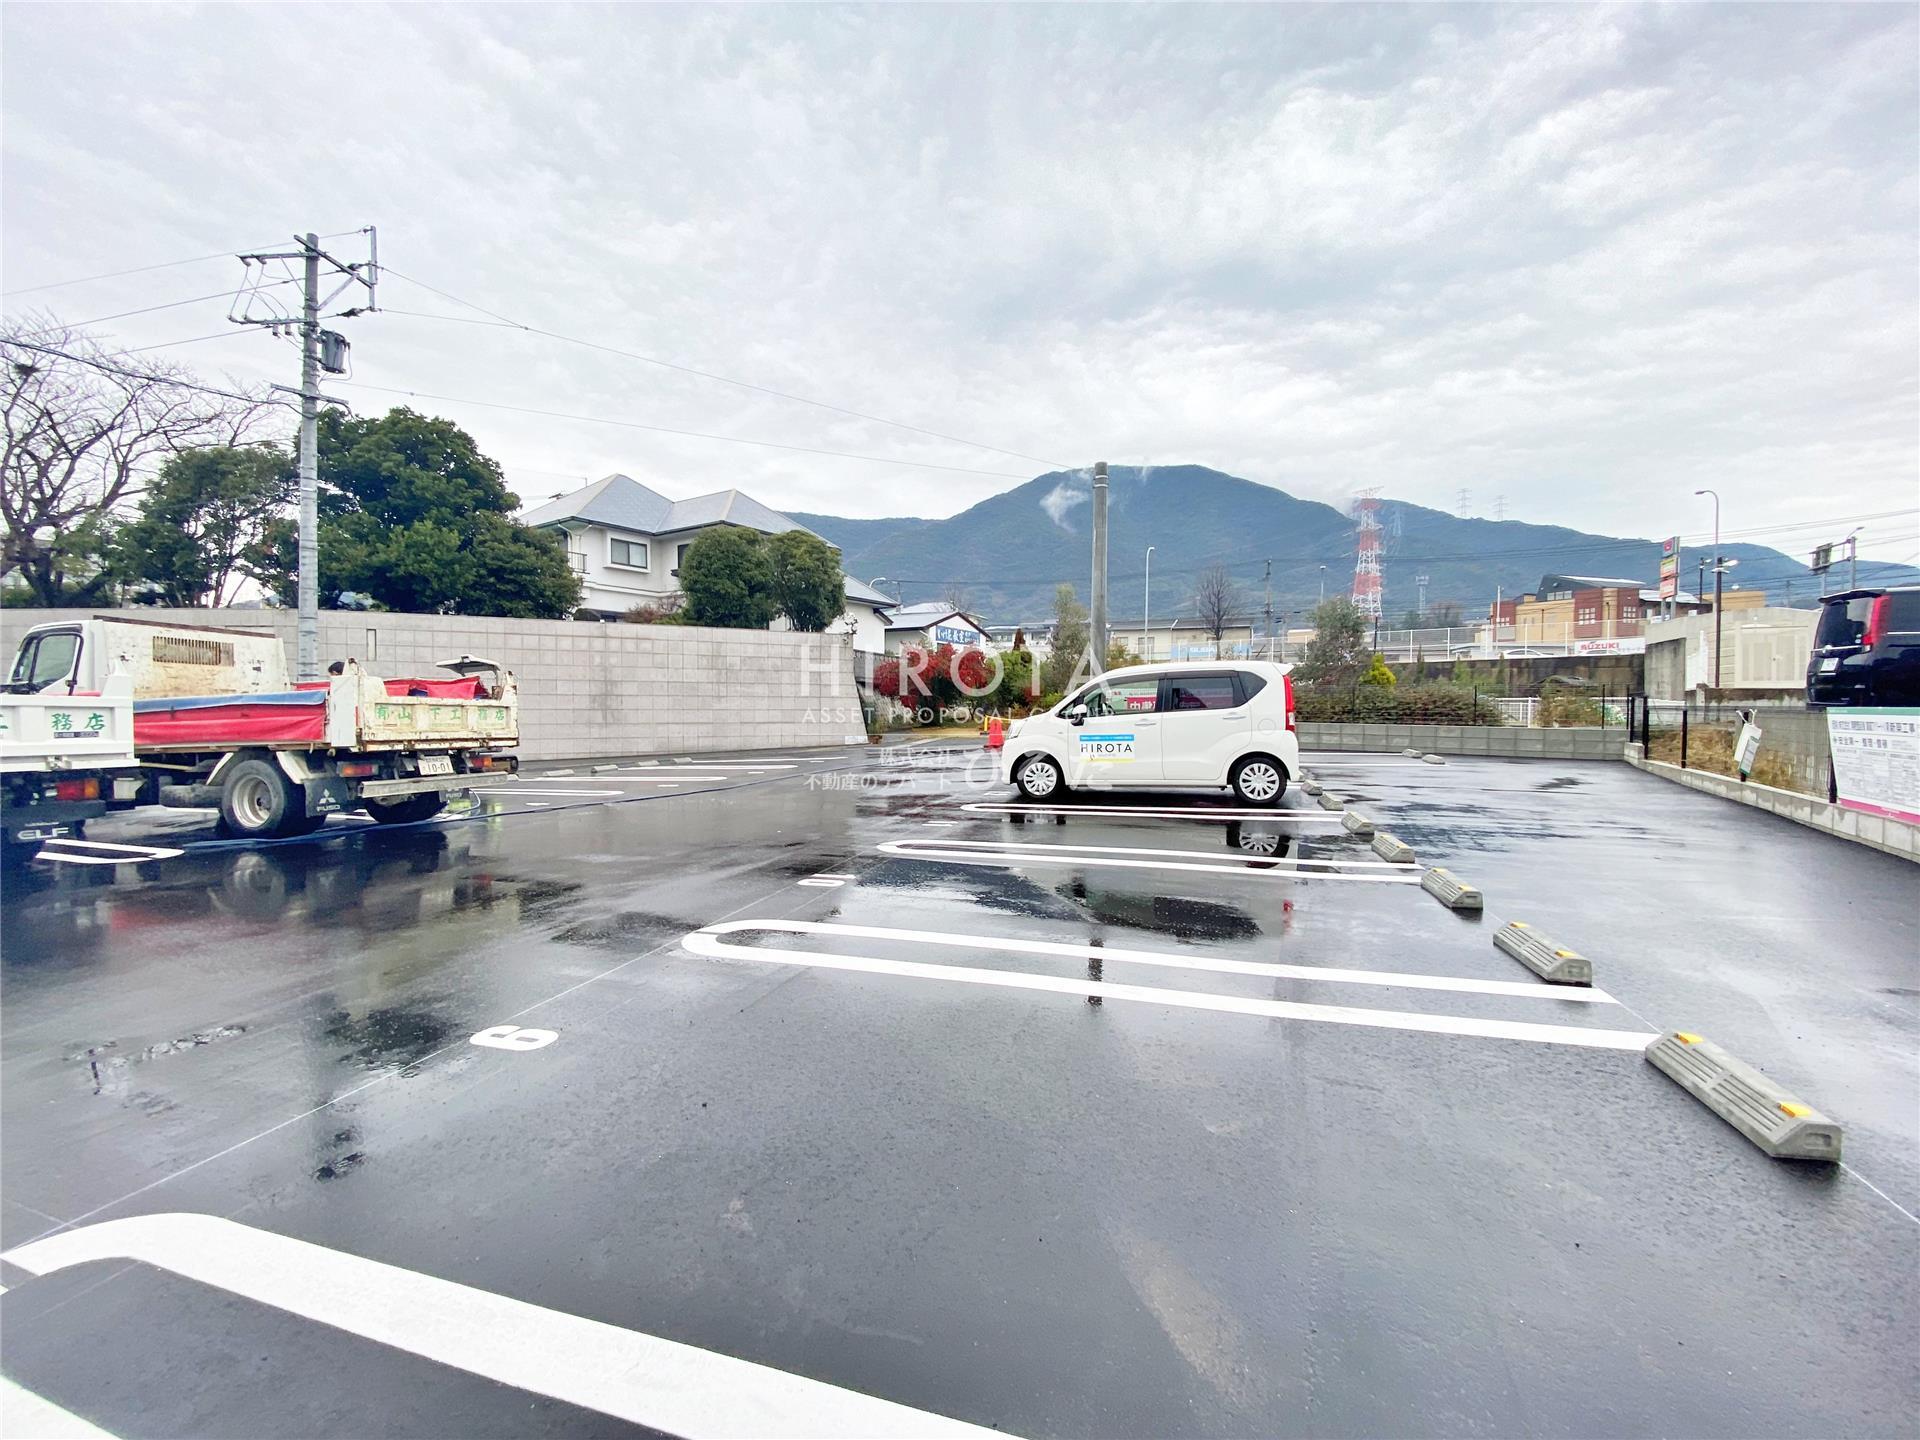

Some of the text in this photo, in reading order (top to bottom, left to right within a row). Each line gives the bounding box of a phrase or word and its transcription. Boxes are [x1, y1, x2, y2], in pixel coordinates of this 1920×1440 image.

[1580, 642, 1619, 650] SUZUKI
[1080, 743, 1133, 753] HIROTA
[316, 804, 341, 813] FUSO
[17, 827, 70, 840] ELF
